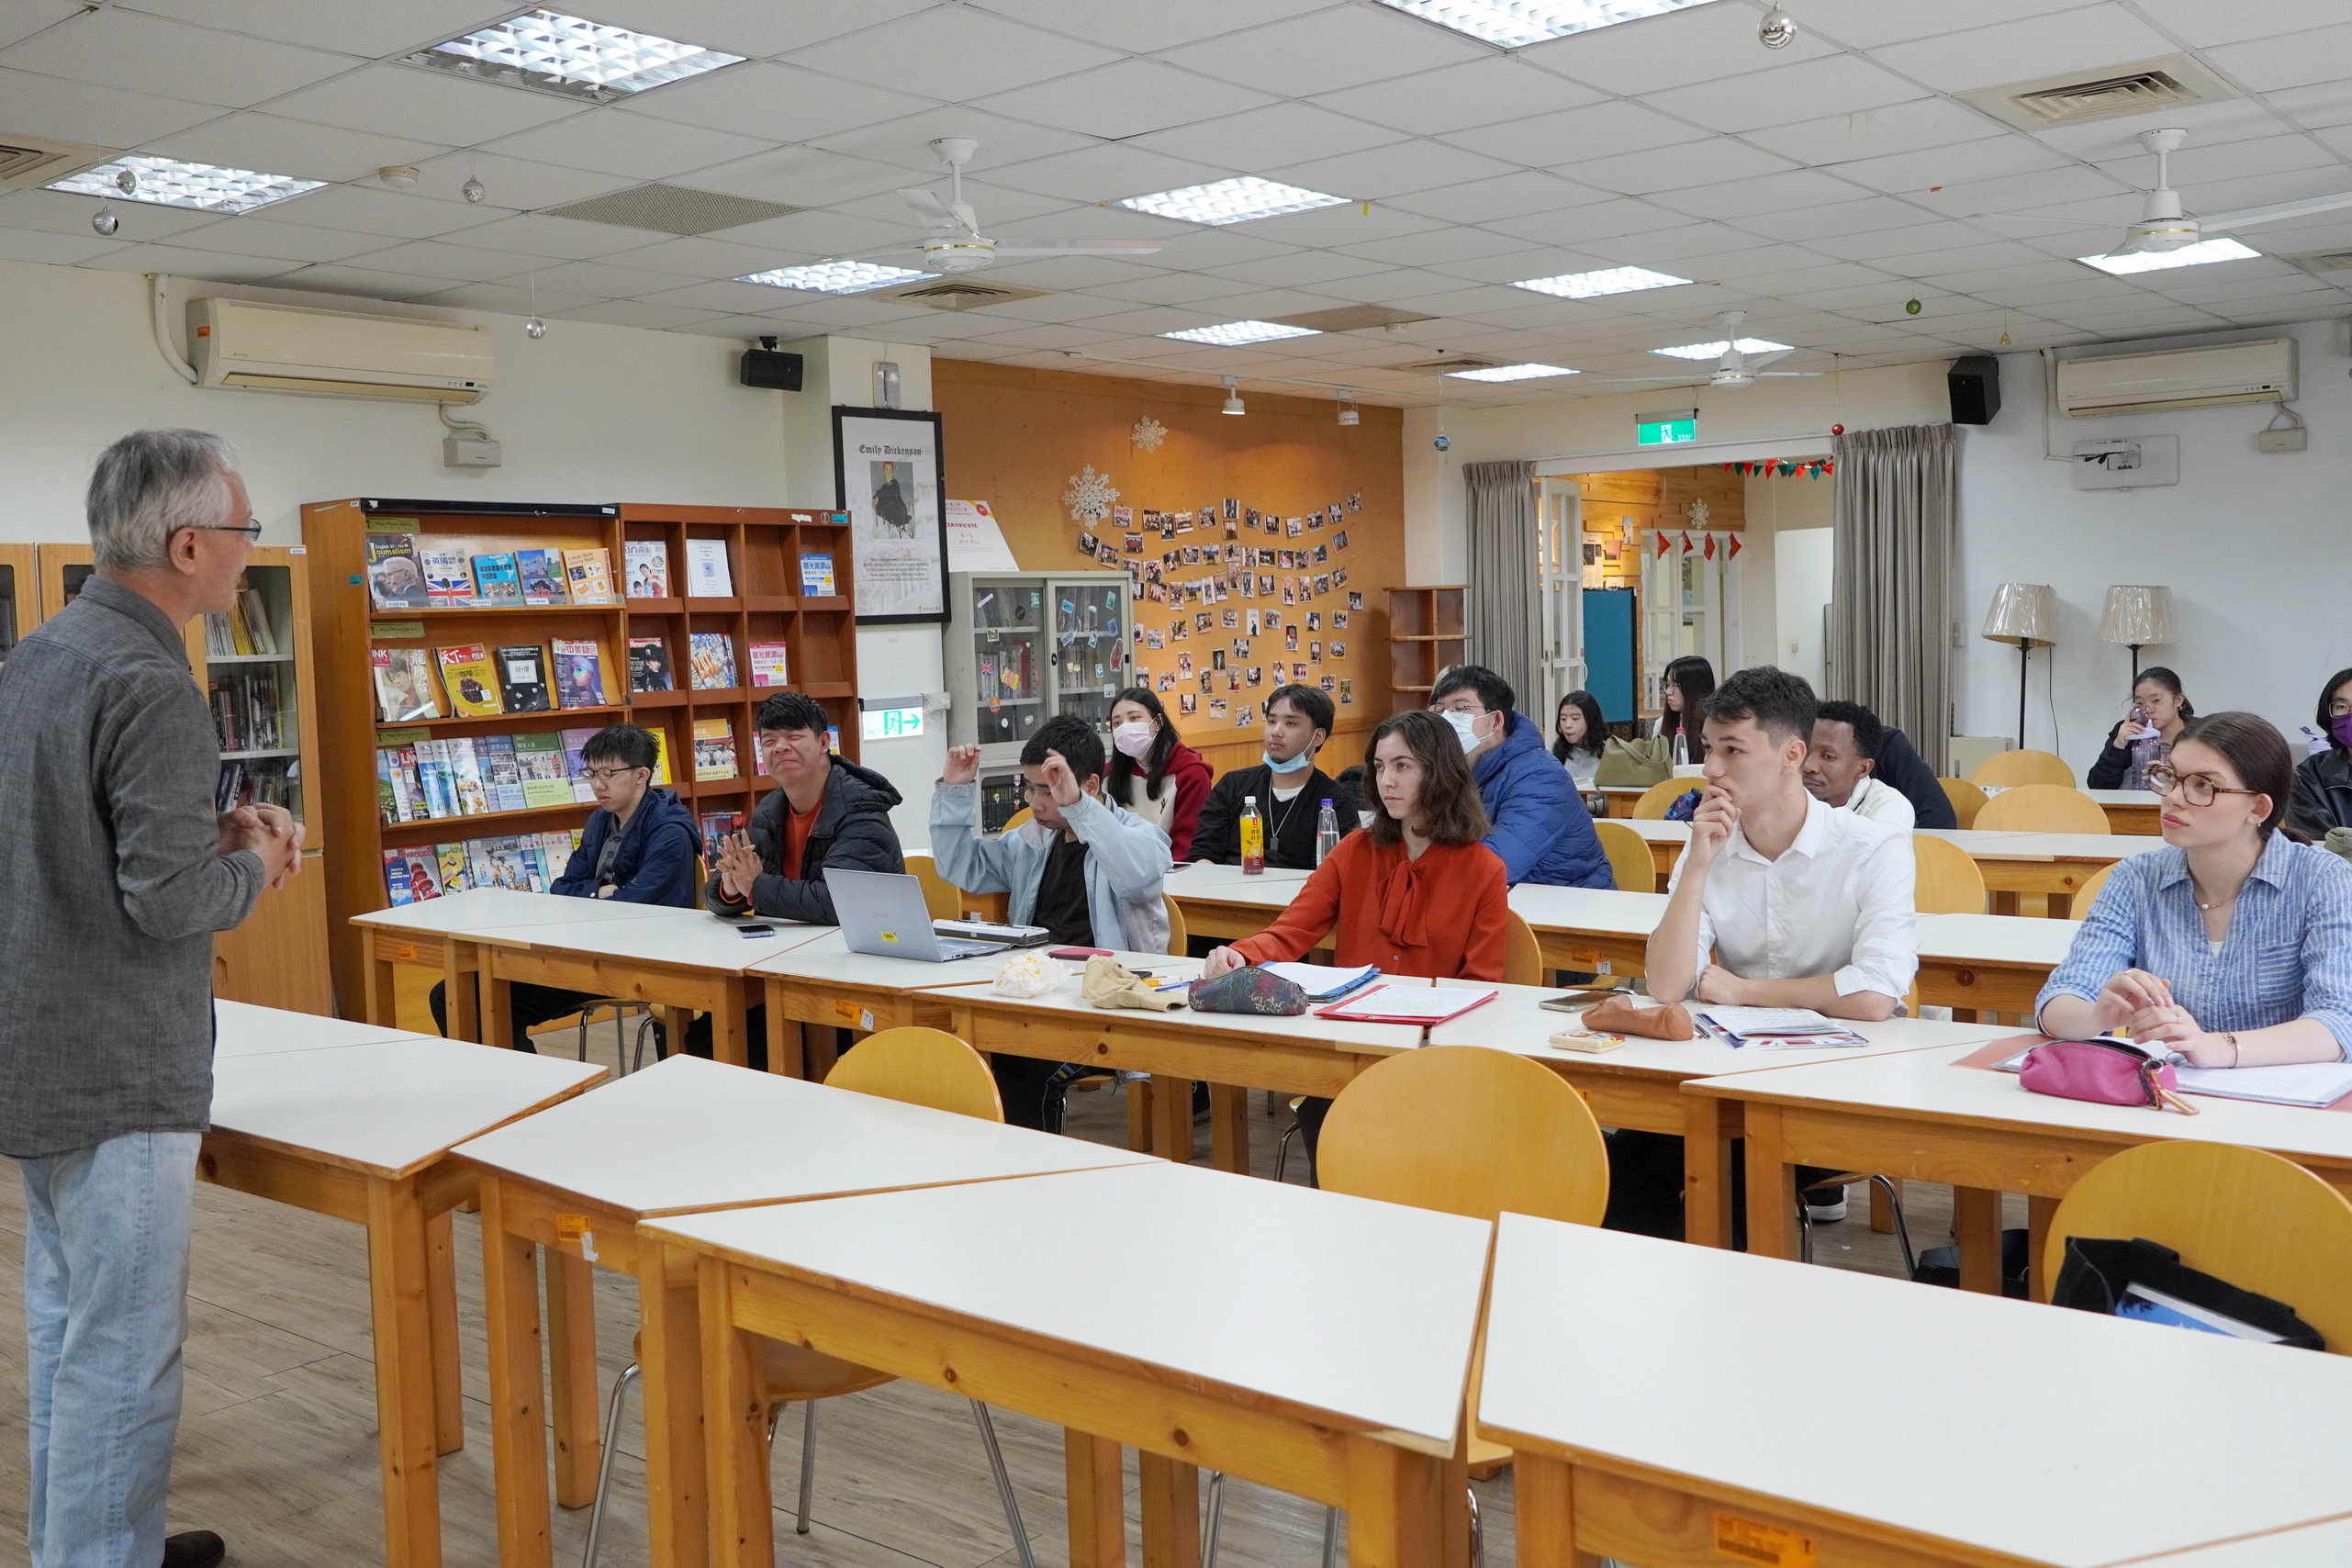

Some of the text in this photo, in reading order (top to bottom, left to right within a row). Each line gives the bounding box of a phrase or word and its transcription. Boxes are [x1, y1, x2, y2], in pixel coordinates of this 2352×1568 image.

[859, 444, 922, 455] Emily Dickenson
[372, 649, 388, 658] INK
[703, 820, 743, 833] TIME
